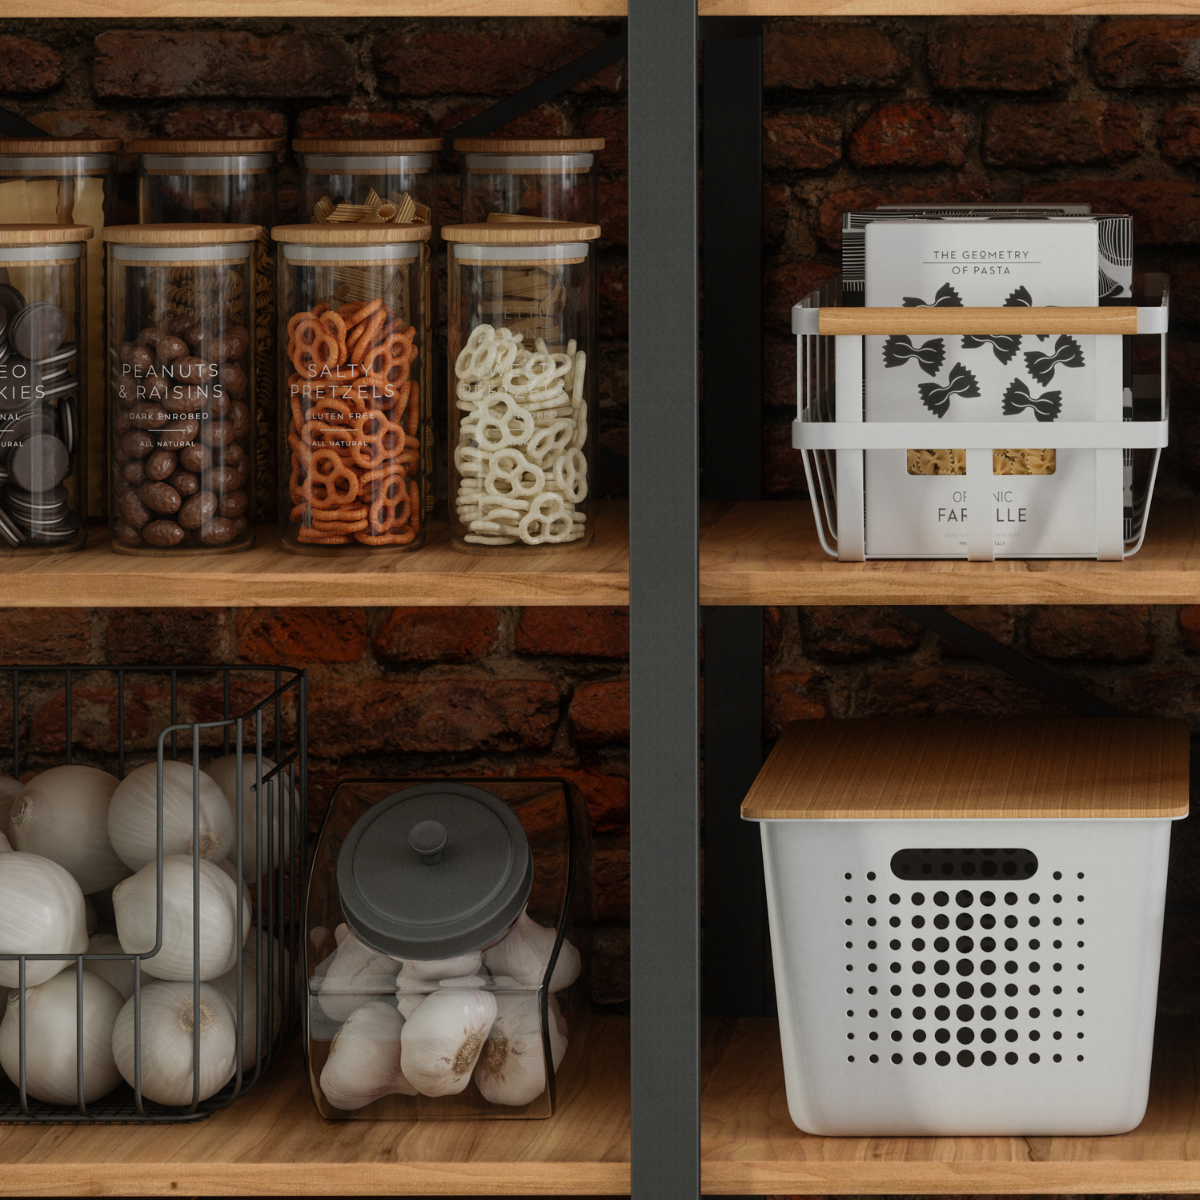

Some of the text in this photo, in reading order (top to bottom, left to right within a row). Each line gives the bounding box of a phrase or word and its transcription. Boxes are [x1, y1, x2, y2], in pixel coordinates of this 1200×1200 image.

[933, 250, 1029, 259] THE GEOMETRY
[952, 266, 1011, 275] OF PASTA
[0, 364, 27, 379] EO
[122, 363, 219, 378] PEANUTS
[308, 363, 372, 378] SALTY
[0, 385, 46, 400] KIES
[118, 384, 223, 400] & RAISINS
[290, 384, 395, 399] PRETZELS
[129, 412, 209, 420] DARK ENROBED
[306, 412, 375, 420] GLUTEN FREE
[938, 507, 1027, 522] FARLLE
